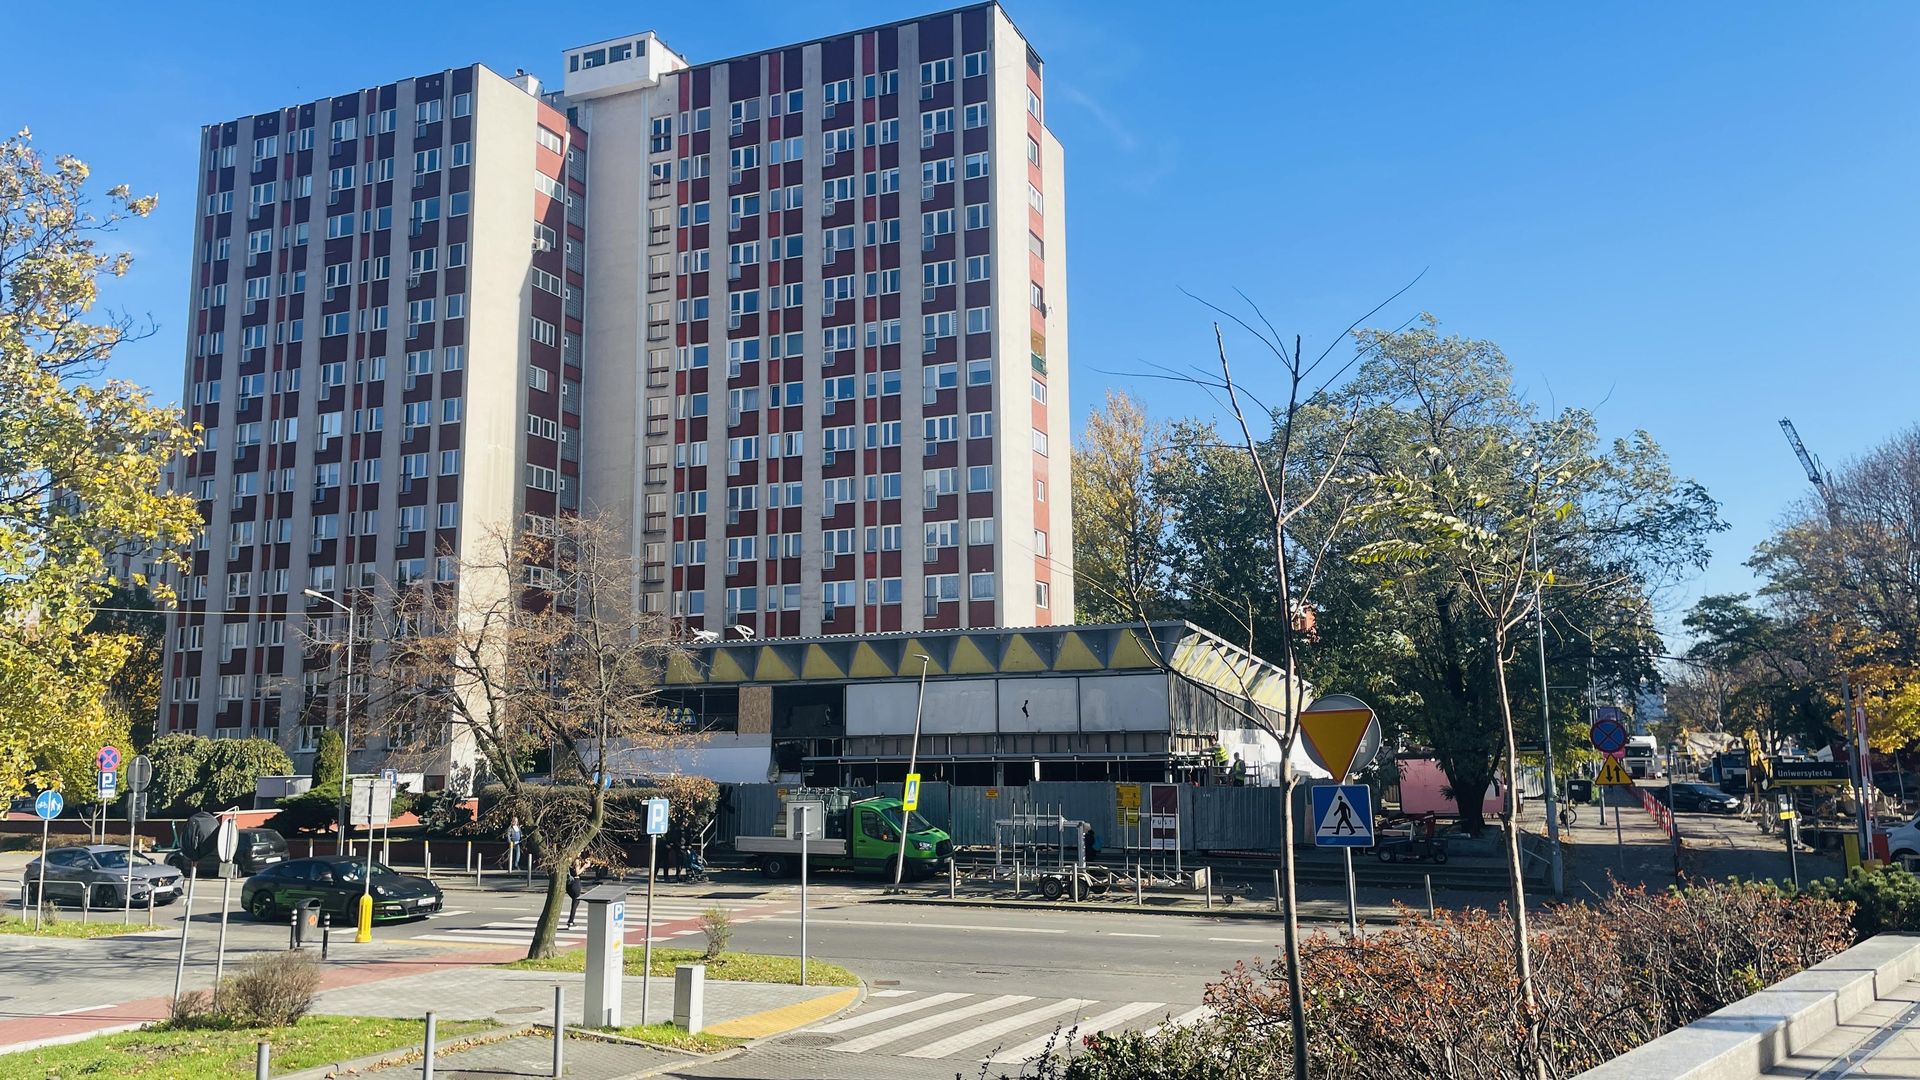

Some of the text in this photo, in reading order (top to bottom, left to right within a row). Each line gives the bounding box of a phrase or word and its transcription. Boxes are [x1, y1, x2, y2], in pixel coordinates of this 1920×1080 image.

[102, 772, 113, 788] P
[1777, 769, 1833, 778] Uniwersytecka
[651, 803, 665, 830] P
[615, 904, 623, 920] P
